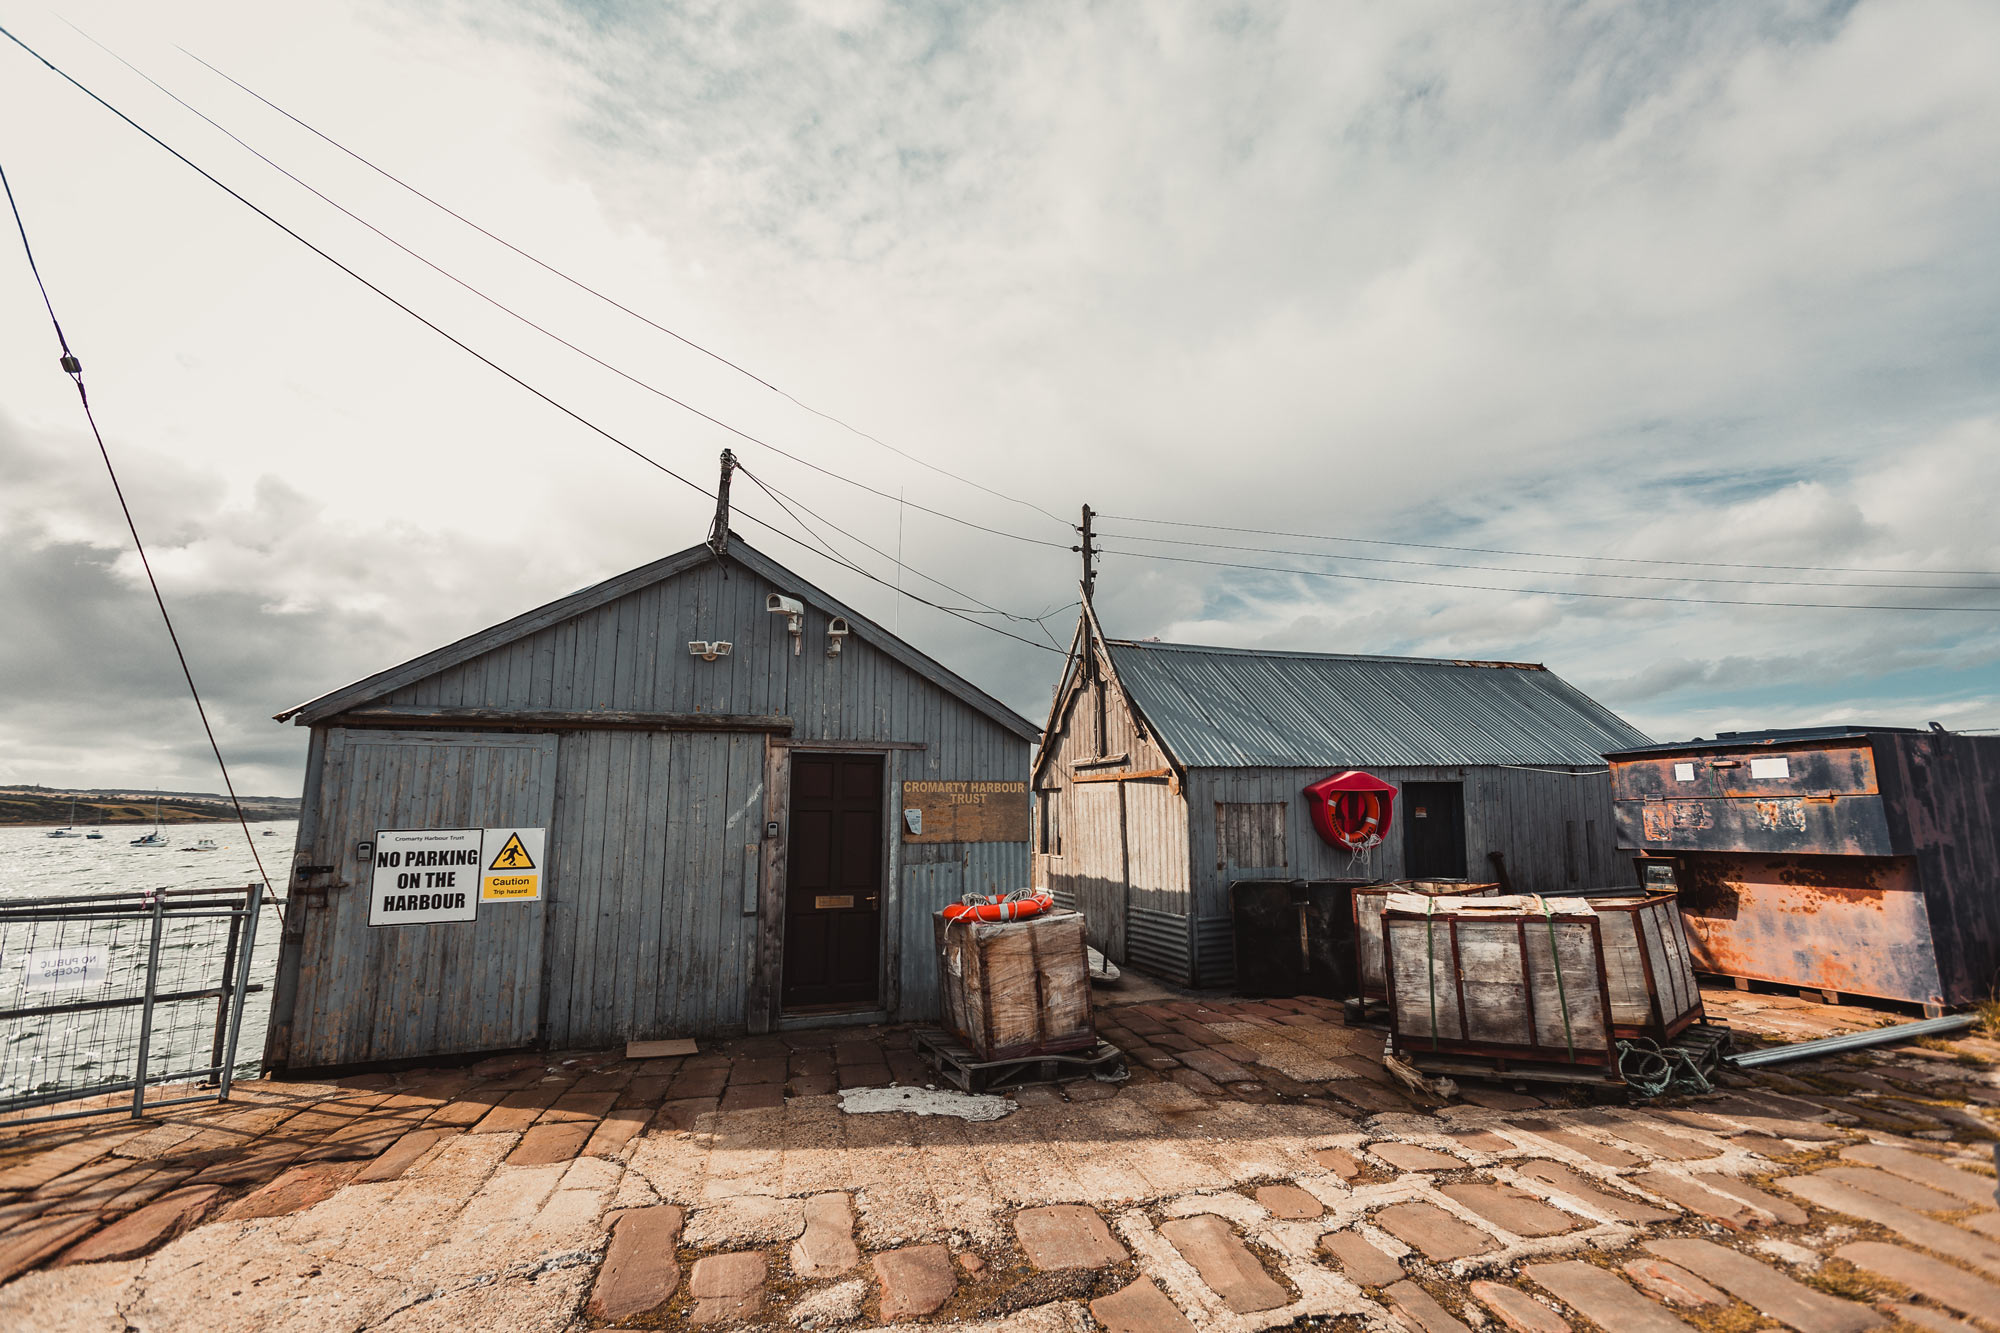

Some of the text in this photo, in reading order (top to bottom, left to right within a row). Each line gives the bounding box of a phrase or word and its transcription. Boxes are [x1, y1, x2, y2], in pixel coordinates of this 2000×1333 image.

[903, 781, 1025, 793] CROMARTY HARBOUR
[950, 793, 987, 804] TRUST
[377, 849, 478, 868] NO PARKING
[397, 871, 456, 889] ON THE
[492, 877, 530, 886] Caution
[383, 893, 466, 912] HARBOUR
